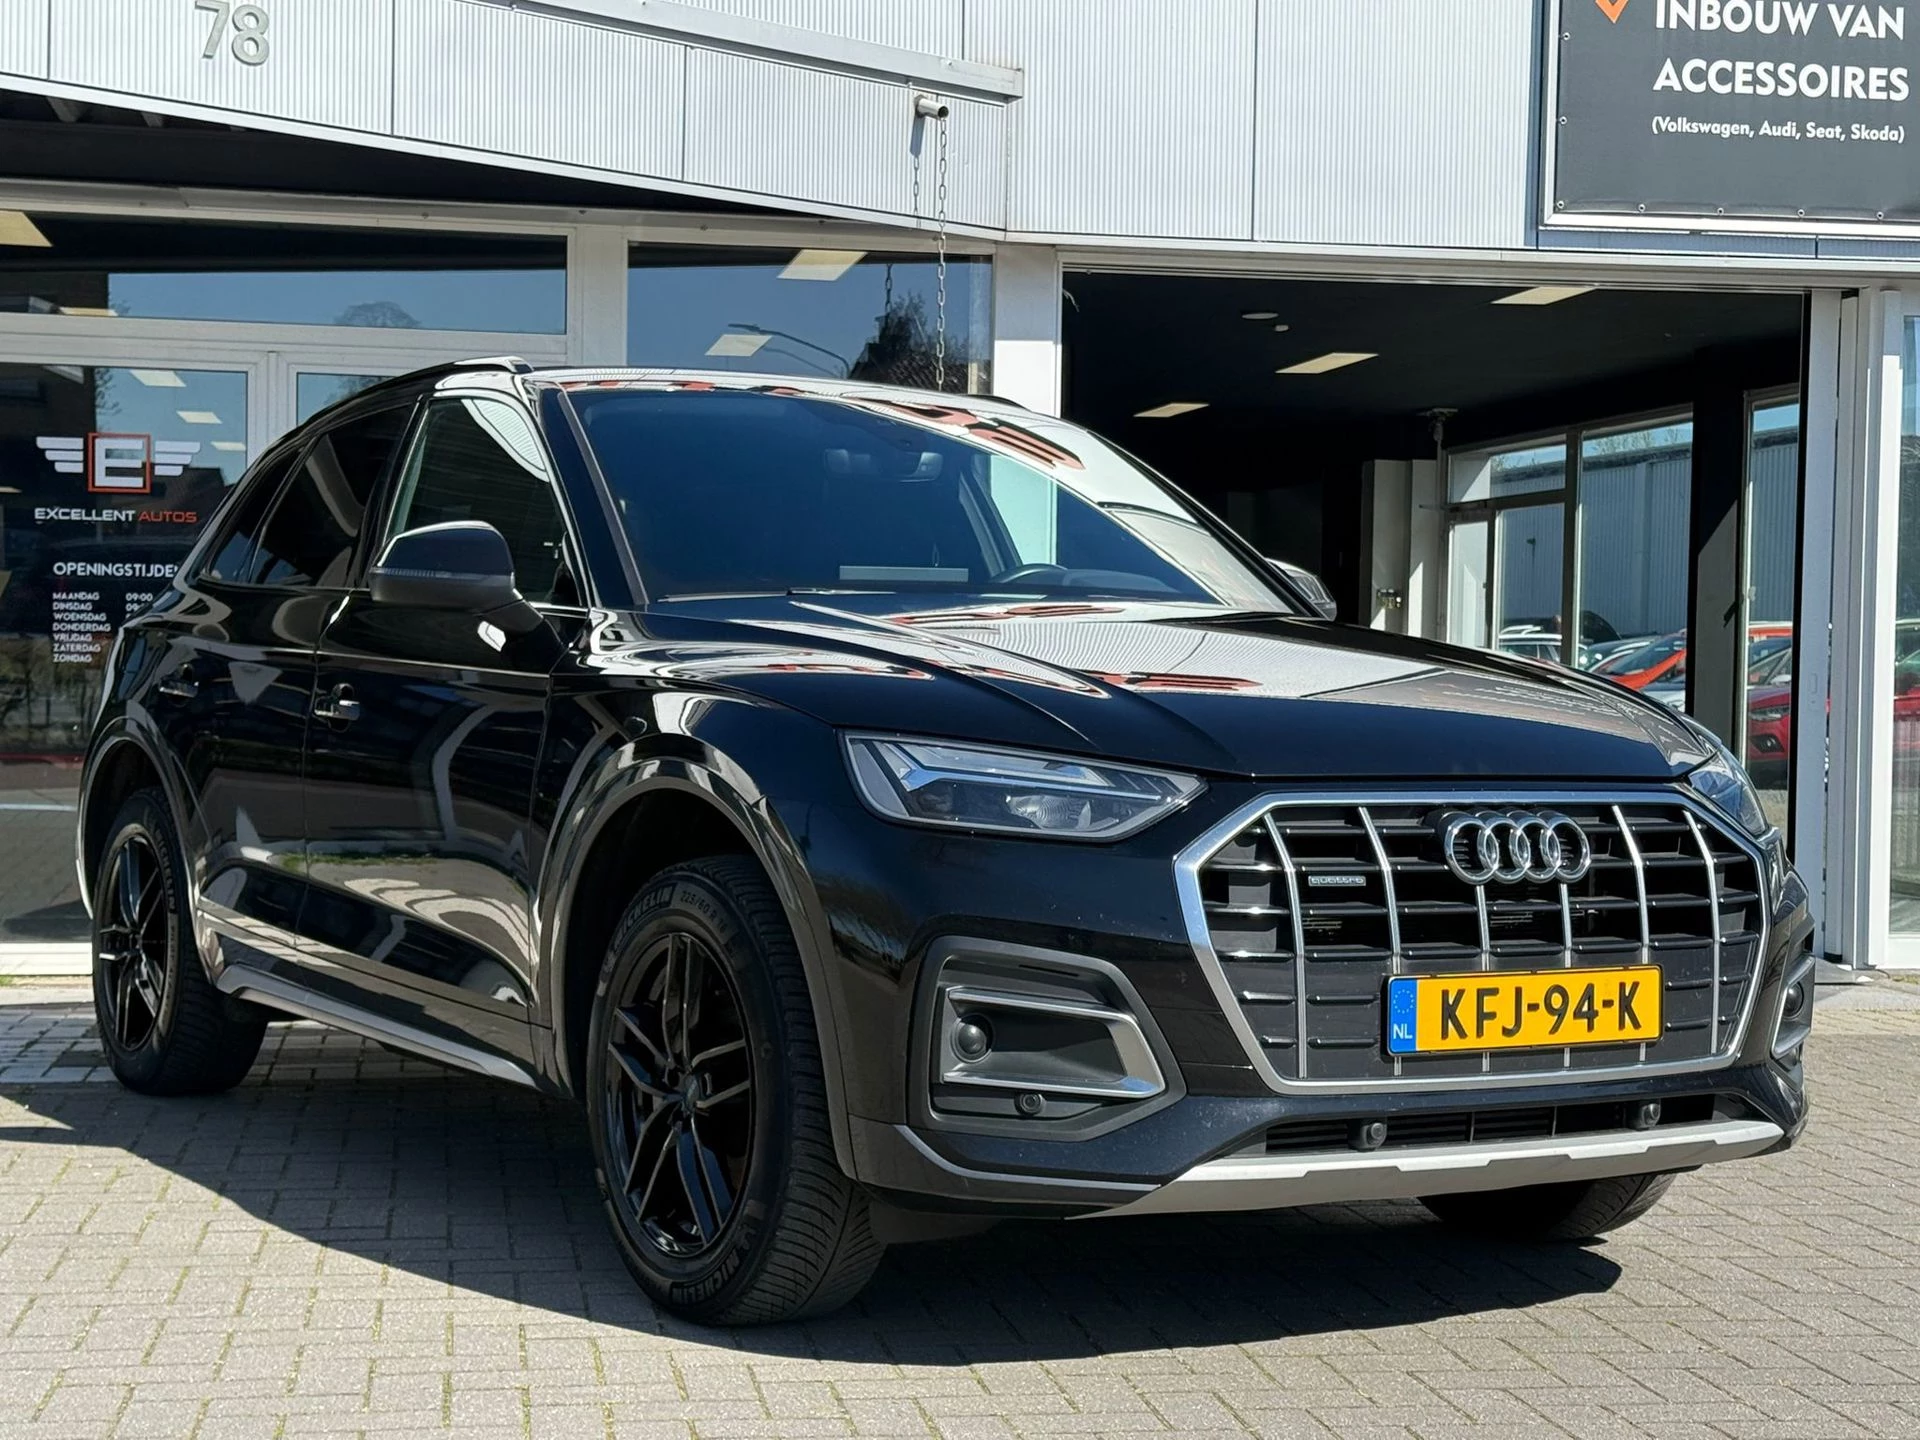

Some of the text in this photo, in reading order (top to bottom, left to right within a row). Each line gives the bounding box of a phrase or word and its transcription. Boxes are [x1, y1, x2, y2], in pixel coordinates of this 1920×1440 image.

[1655, 0, 1905, 40] INBOUW VAN
[194, 0, 270, 66] 78
[1652, 57, 1910, 101] ACCESSOIRES
[1651, 116, 1905, 144] (Volkswagen, Audi, Seat, Skoda)
[34, 507, 197, 523] EXCELLENT AUTOS
[53, 562, 178, 578] OPENINGSTIJDE
[52, 592, 153, 602] MAANDAG 09:00
[52, 602, 93, 611] DINSDAG
[52, 612, 107, 622] WOENSDAG
[52, 622, 111, 632] DONDERDAG
[52, 633, 93, 642] VRIJDAG
[52, 643, 101, 652] ZATERDAG
[52, 654, 93, 663] ZONDAG
[1440, 981, 1642, 1041] KFJ-94-K
[1393, 1024, 1413, 1040] NL
